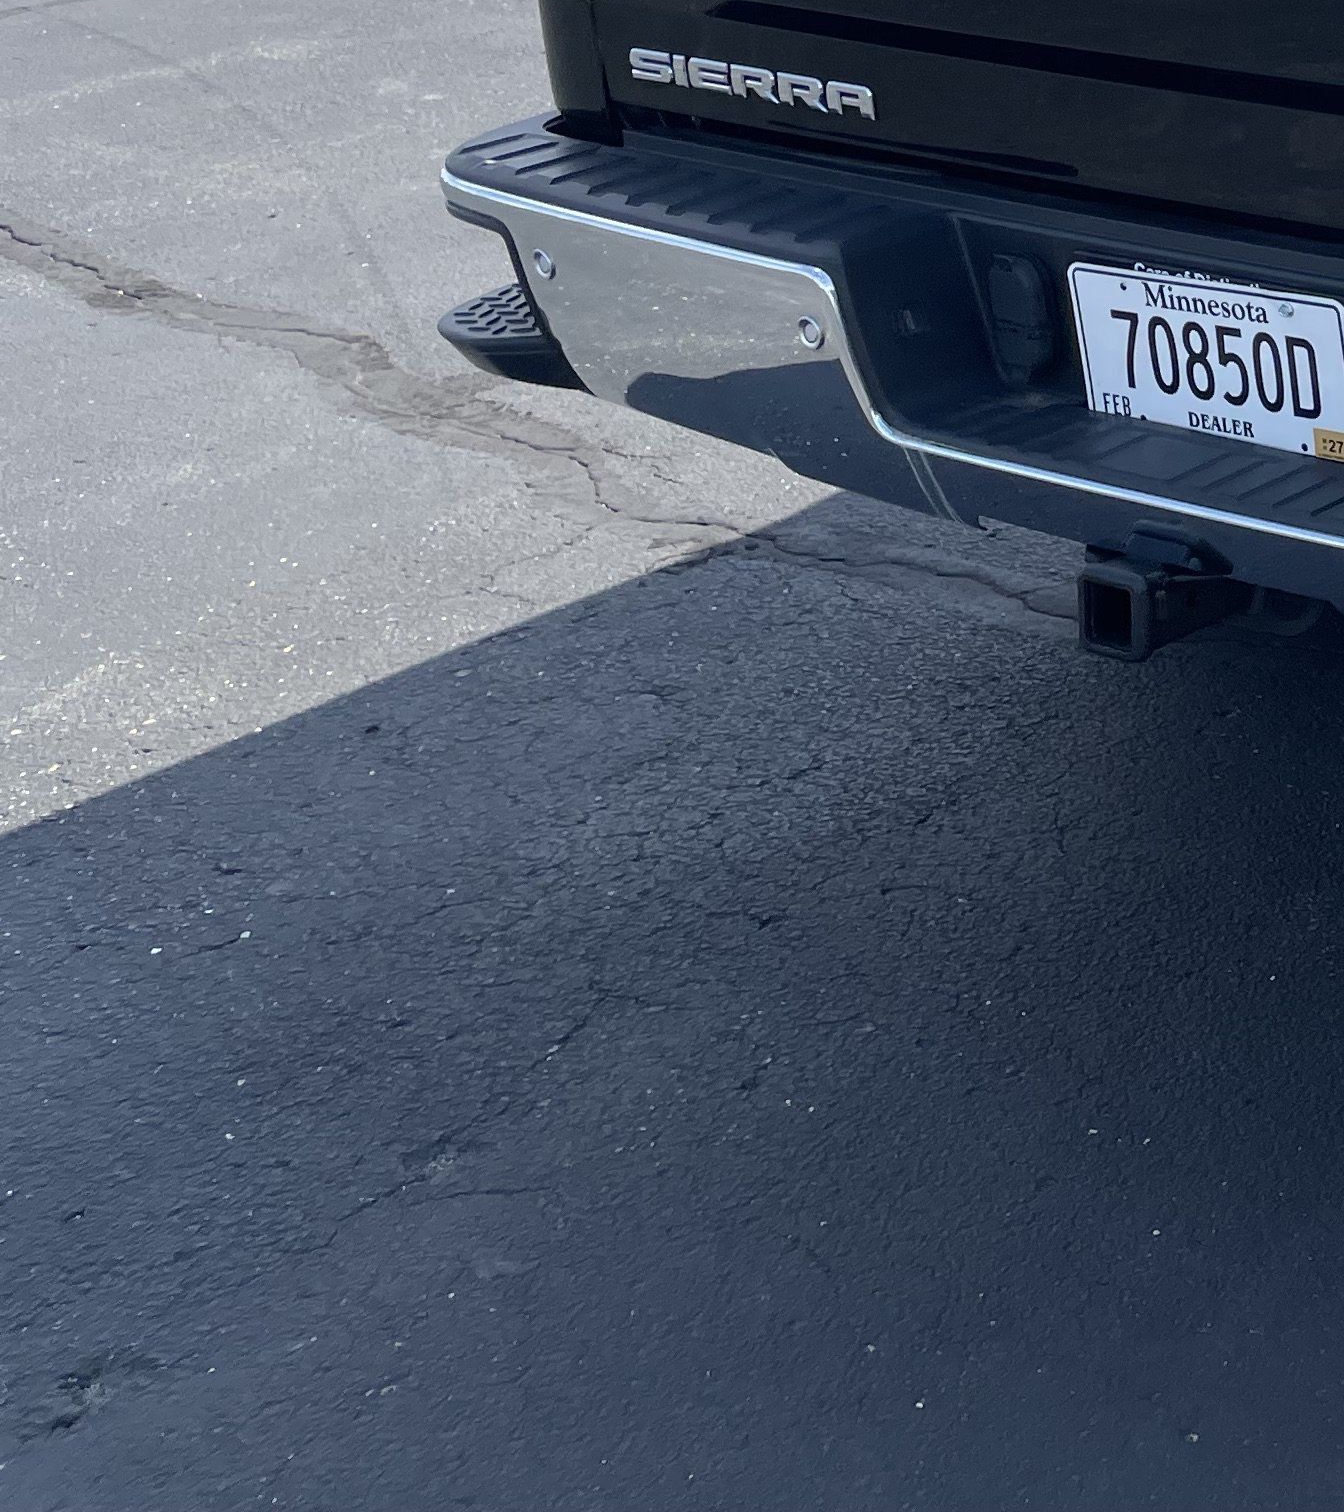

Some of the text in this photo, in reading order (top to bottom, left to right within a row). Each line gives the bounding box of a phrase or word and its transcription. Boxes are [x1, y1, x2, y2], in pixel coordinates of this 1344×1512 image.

[629, 47, 876, 121] SIERRA
[1140, 280, 1269, 324] Minnesota
[1110, 308, 1322, 420] 70850D
[1103, 392, 1133, 418] FEB
[1188, 411, 1256, 438] DEALER
[1328, 439, 1344, 454] 27
